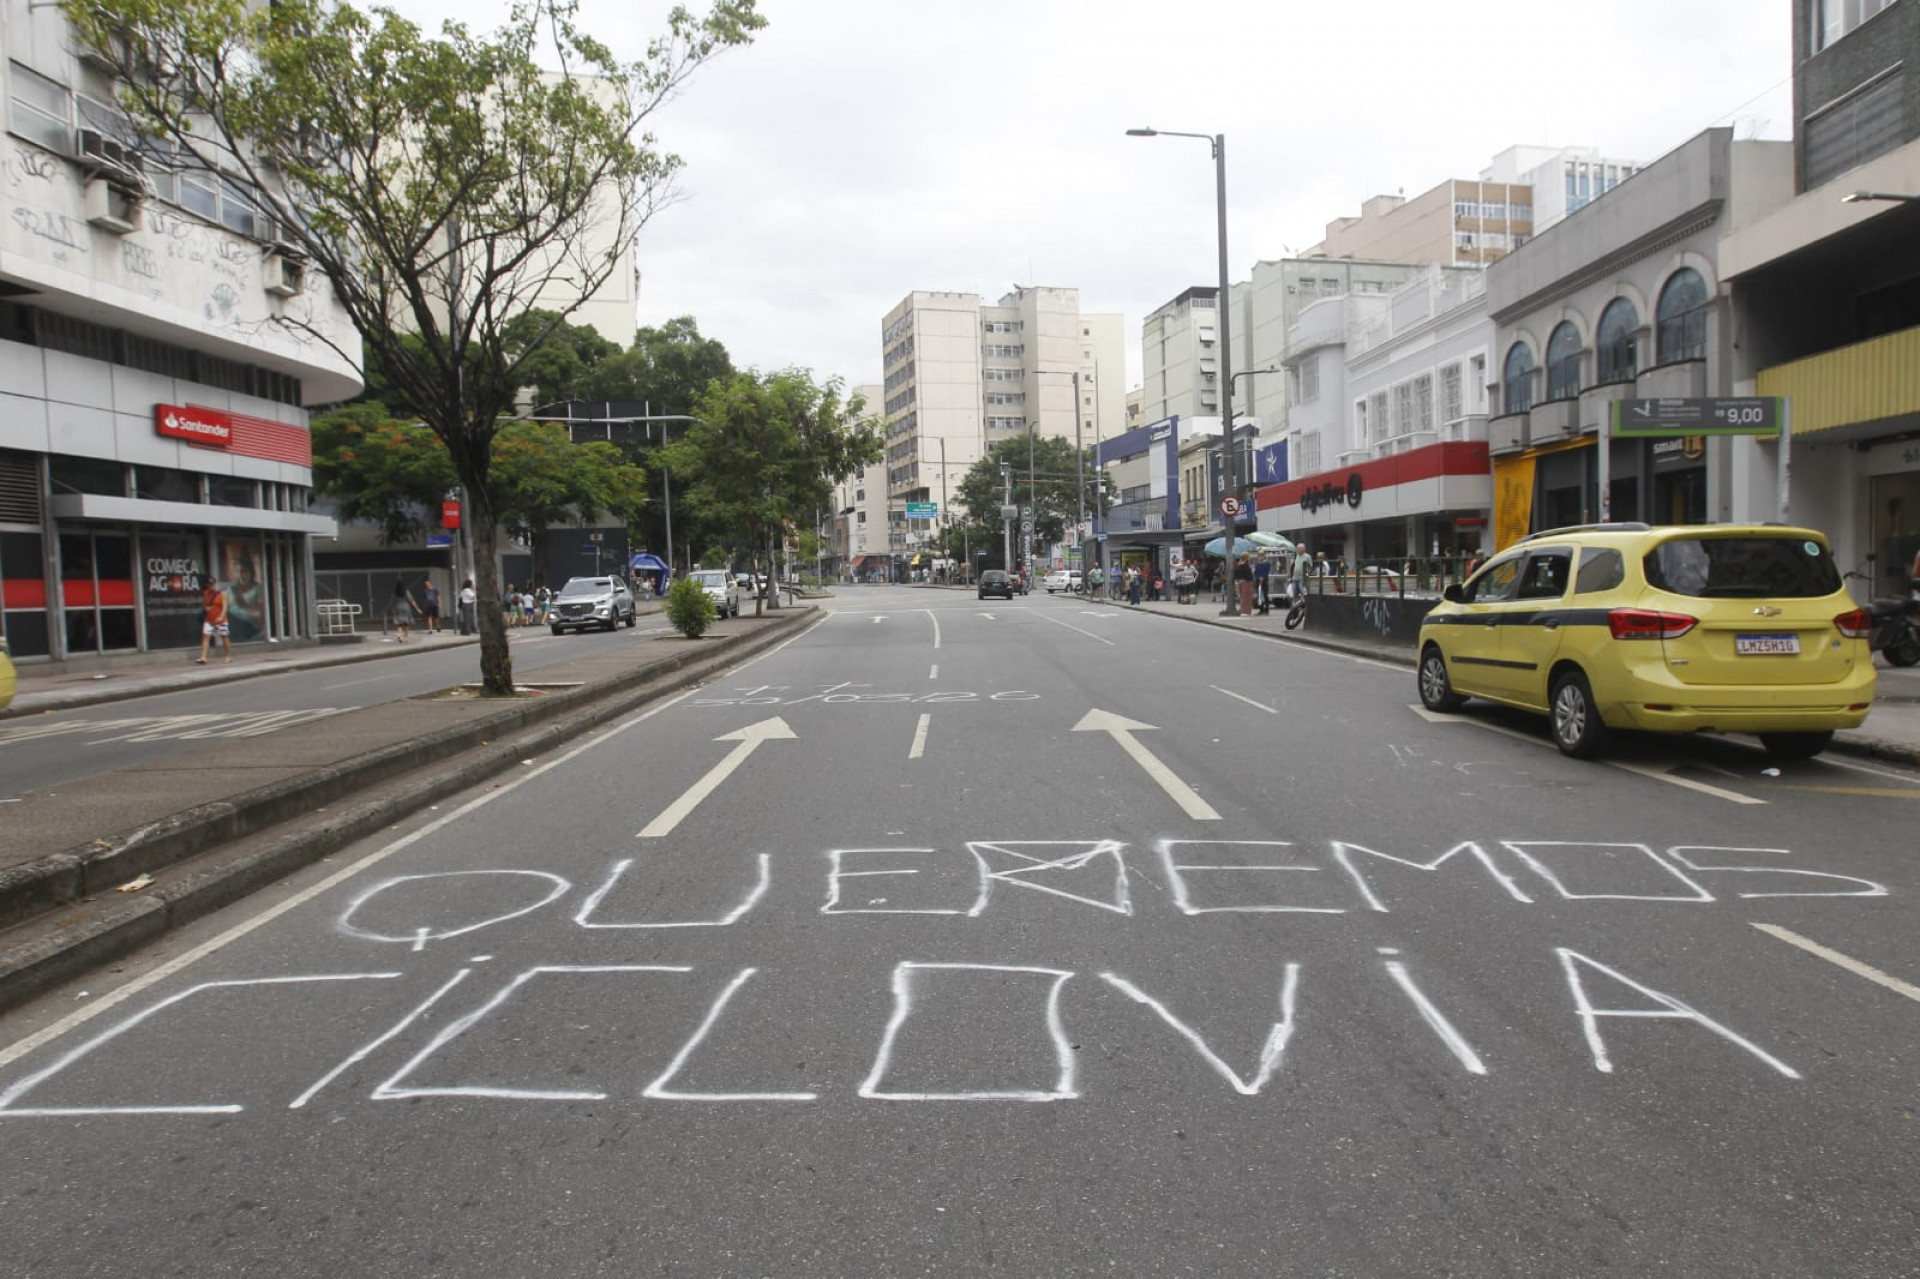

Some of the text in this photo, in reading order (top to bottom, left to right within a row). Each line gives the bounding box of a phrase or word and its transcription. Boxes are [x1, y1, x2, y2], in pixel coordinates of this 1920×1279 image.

[1727, 407, 1763, 425] 9,00
[179, 417, 230, 438] Santander
[1653, 438, 1684, 454] smart
[334, 838, 1890, 952] QUEREMOS
